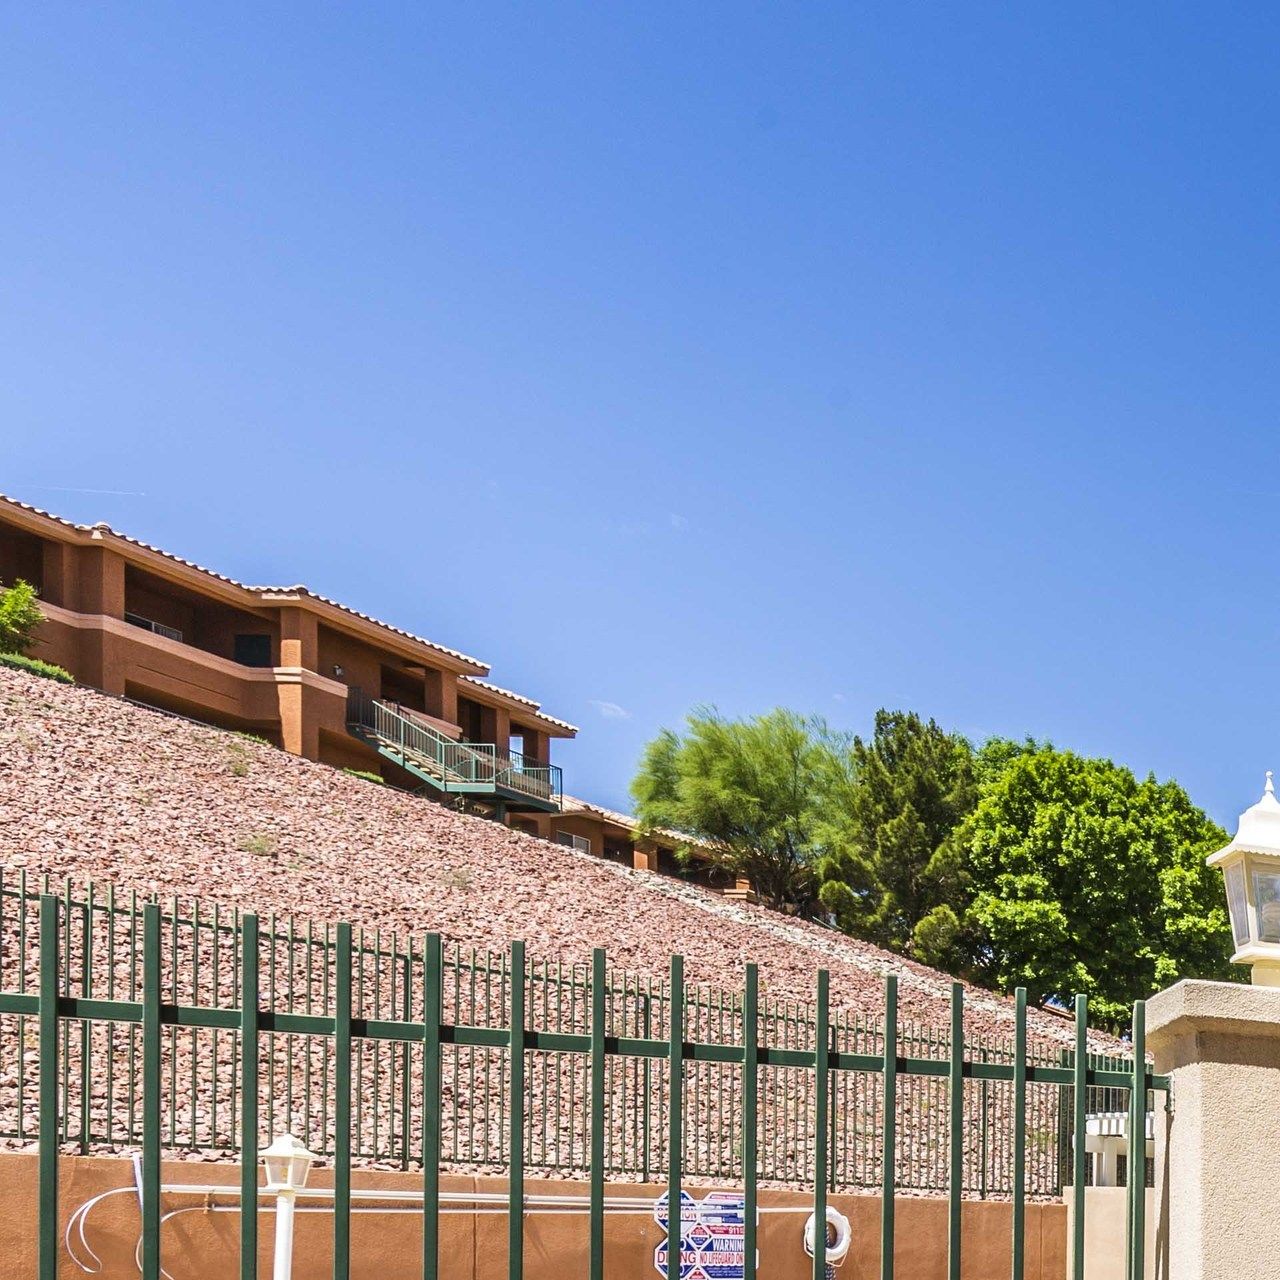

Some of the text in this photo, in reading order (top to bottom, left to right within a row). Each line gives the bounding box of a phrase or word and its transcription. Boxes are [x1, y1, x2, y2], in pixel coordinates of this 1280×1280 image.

[657, 1206, 697, 1219] CAION
[657, 1252, 696, 1263] DING
[700, 1253, 708, 1264] NO
[709, 1253, 735, 1264] LIFEGUARD
